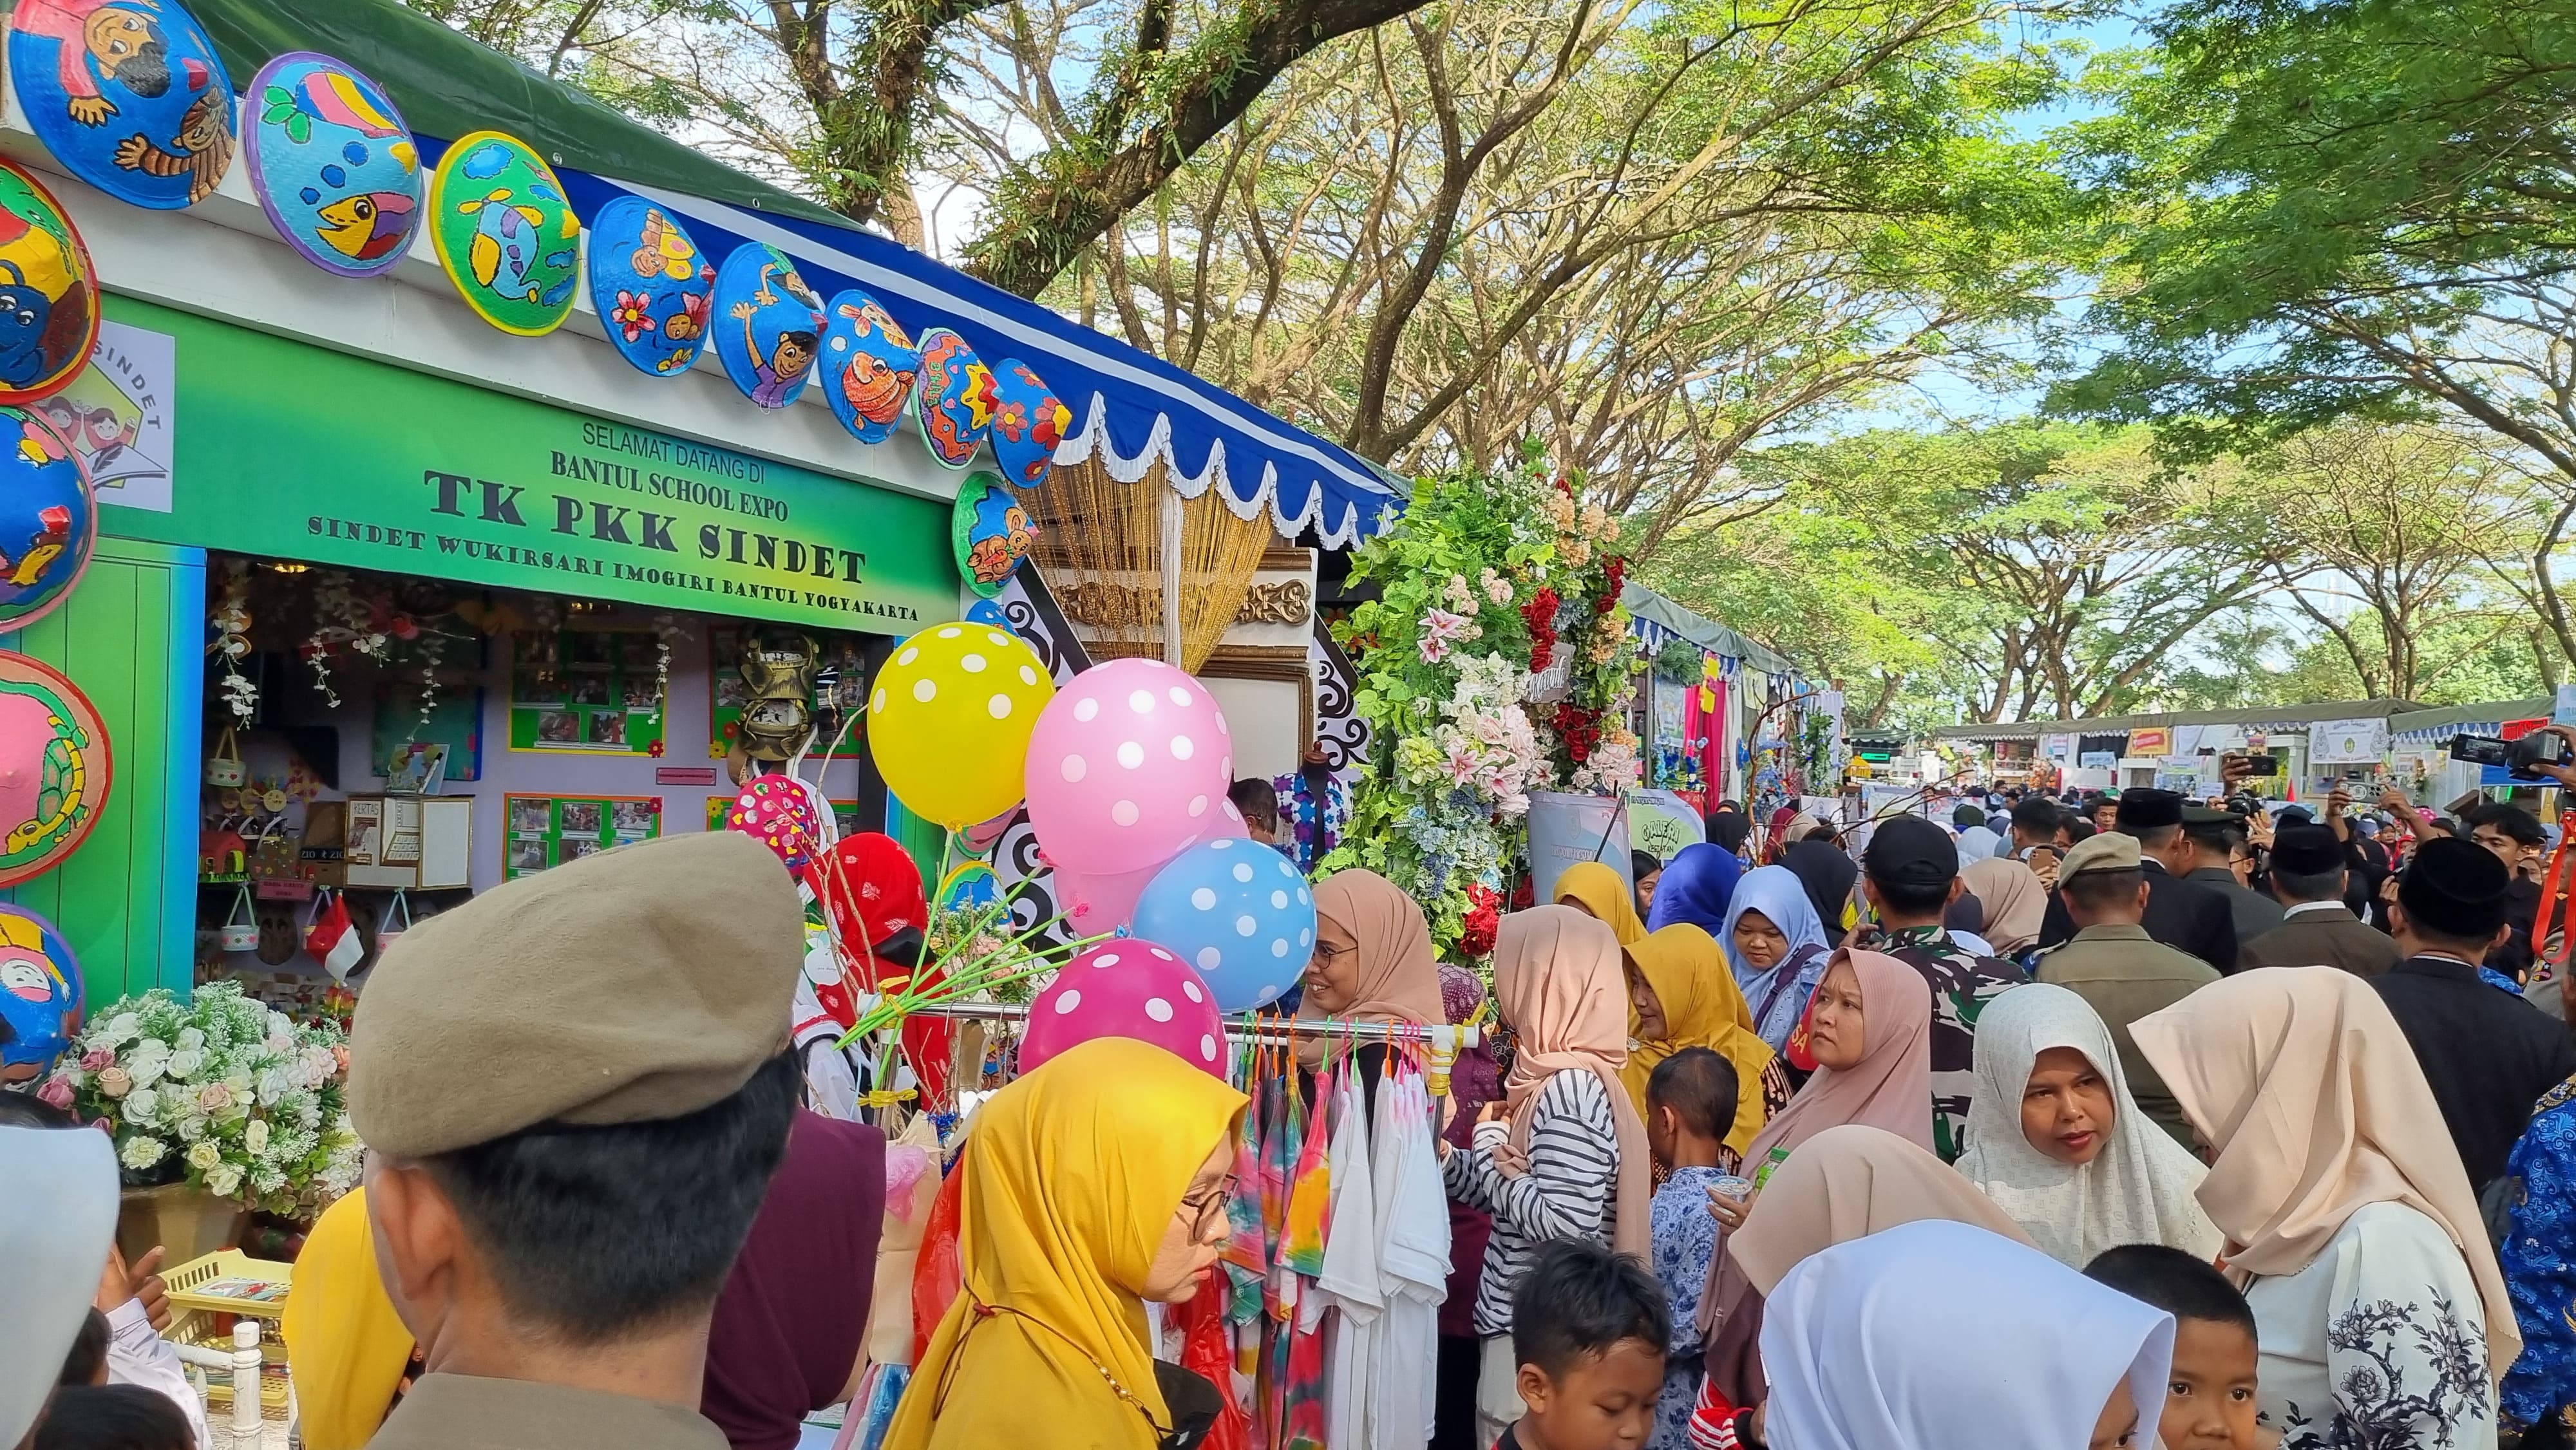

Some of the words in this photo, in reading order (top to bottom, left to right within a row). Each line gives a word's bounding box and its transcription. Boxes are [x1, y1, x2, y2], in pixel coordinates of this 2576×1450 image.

[93, 340, 162, 430] SINDET
[550, 450, 643, 493] BANTUL
[649, 472, 734, 511] SCHOOL
[739, 492, 789, 523] EXPO
[583, 422, 672, 461] SELAMAT
[675, 445, 746, 480] DATANG
[748, 464, 765, 485] DI
[424, 469, 526, 527] TK
[551, 494, 679, 552] PKK
[698, 523, 866, 584] SINDET
[307, 516, 426, 551] SINDET
[436, 534, 604, 576] WUKIRSARI
[612, 562, 715, 592] IMOGIRI
[722, 579, 799, 605] BANTUL
[804, 592, 919, 623] YOGYAKARTA
[1642, 820, 1680, 844] GALERI
